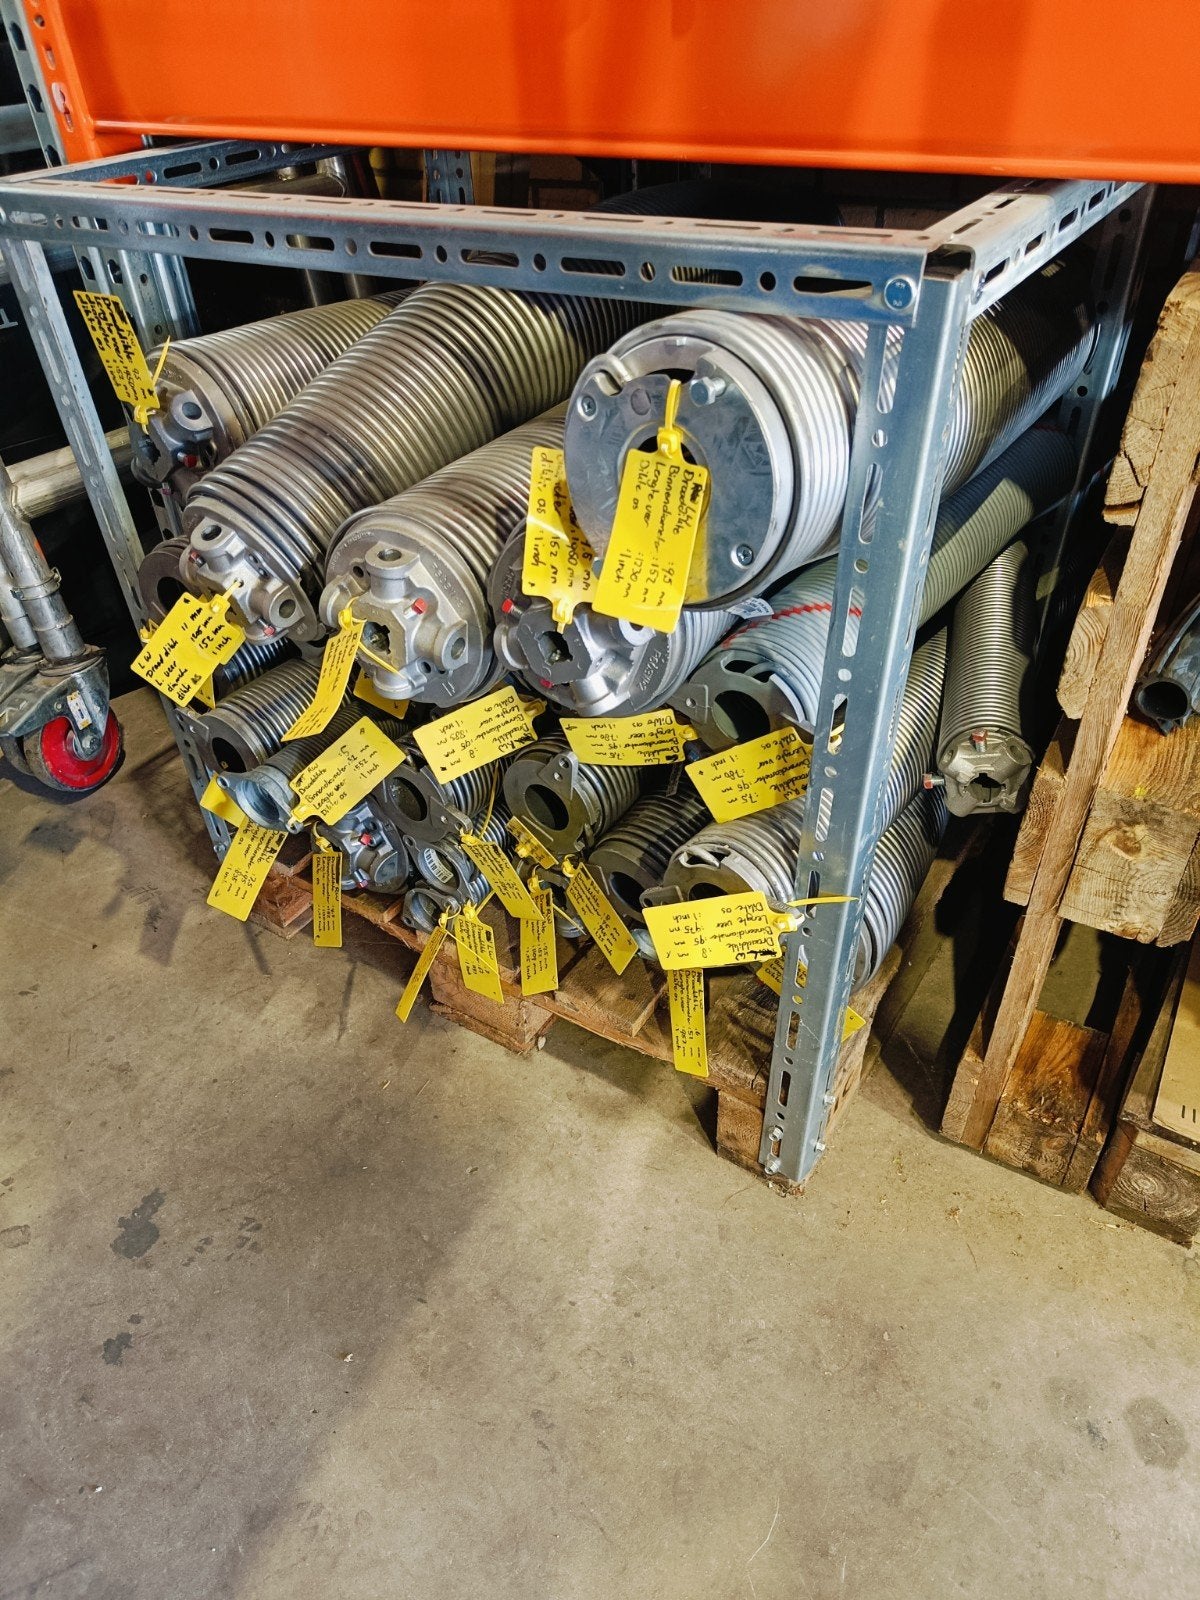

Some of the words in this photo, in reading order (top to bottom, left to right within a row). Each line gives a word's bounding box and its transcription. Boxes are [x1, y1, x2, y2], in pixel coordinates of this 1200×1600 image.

[645, 461, 664, 502] Lengte
[632, 497, 640, 510] as
[530, 543, 547, 567] inch
[614, 559, 625, 583] inch
[214, 635, 232, 652] inch
[672, 913, 690, 923] inch
[736, 912, 768, 927] Lengte
